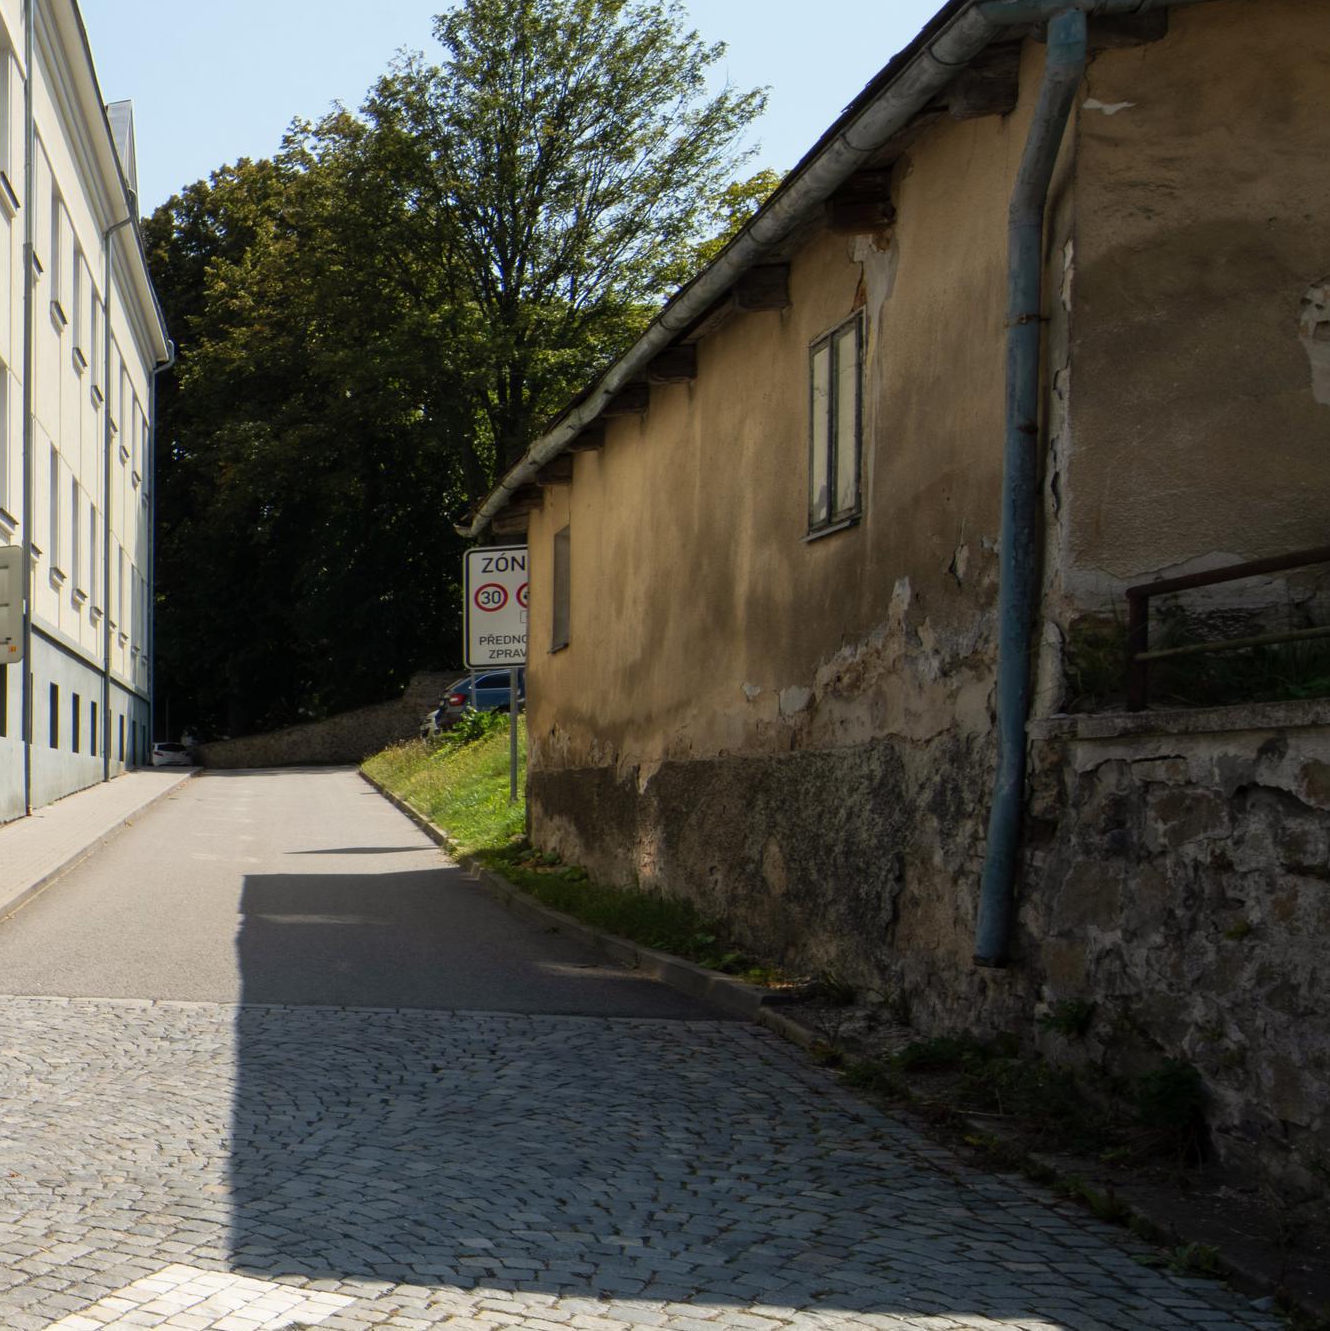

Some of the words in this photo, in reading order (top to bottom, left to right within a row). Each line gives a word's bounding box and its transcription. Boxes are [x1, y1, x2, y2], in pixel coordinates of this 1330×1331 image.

[481, 552, 526, 573] ZÓN
[481, 590, 502, 605] 30
[479, 634, 527, 645] PŘEDNO
[489, 648, 527, 659] ZPRAV
